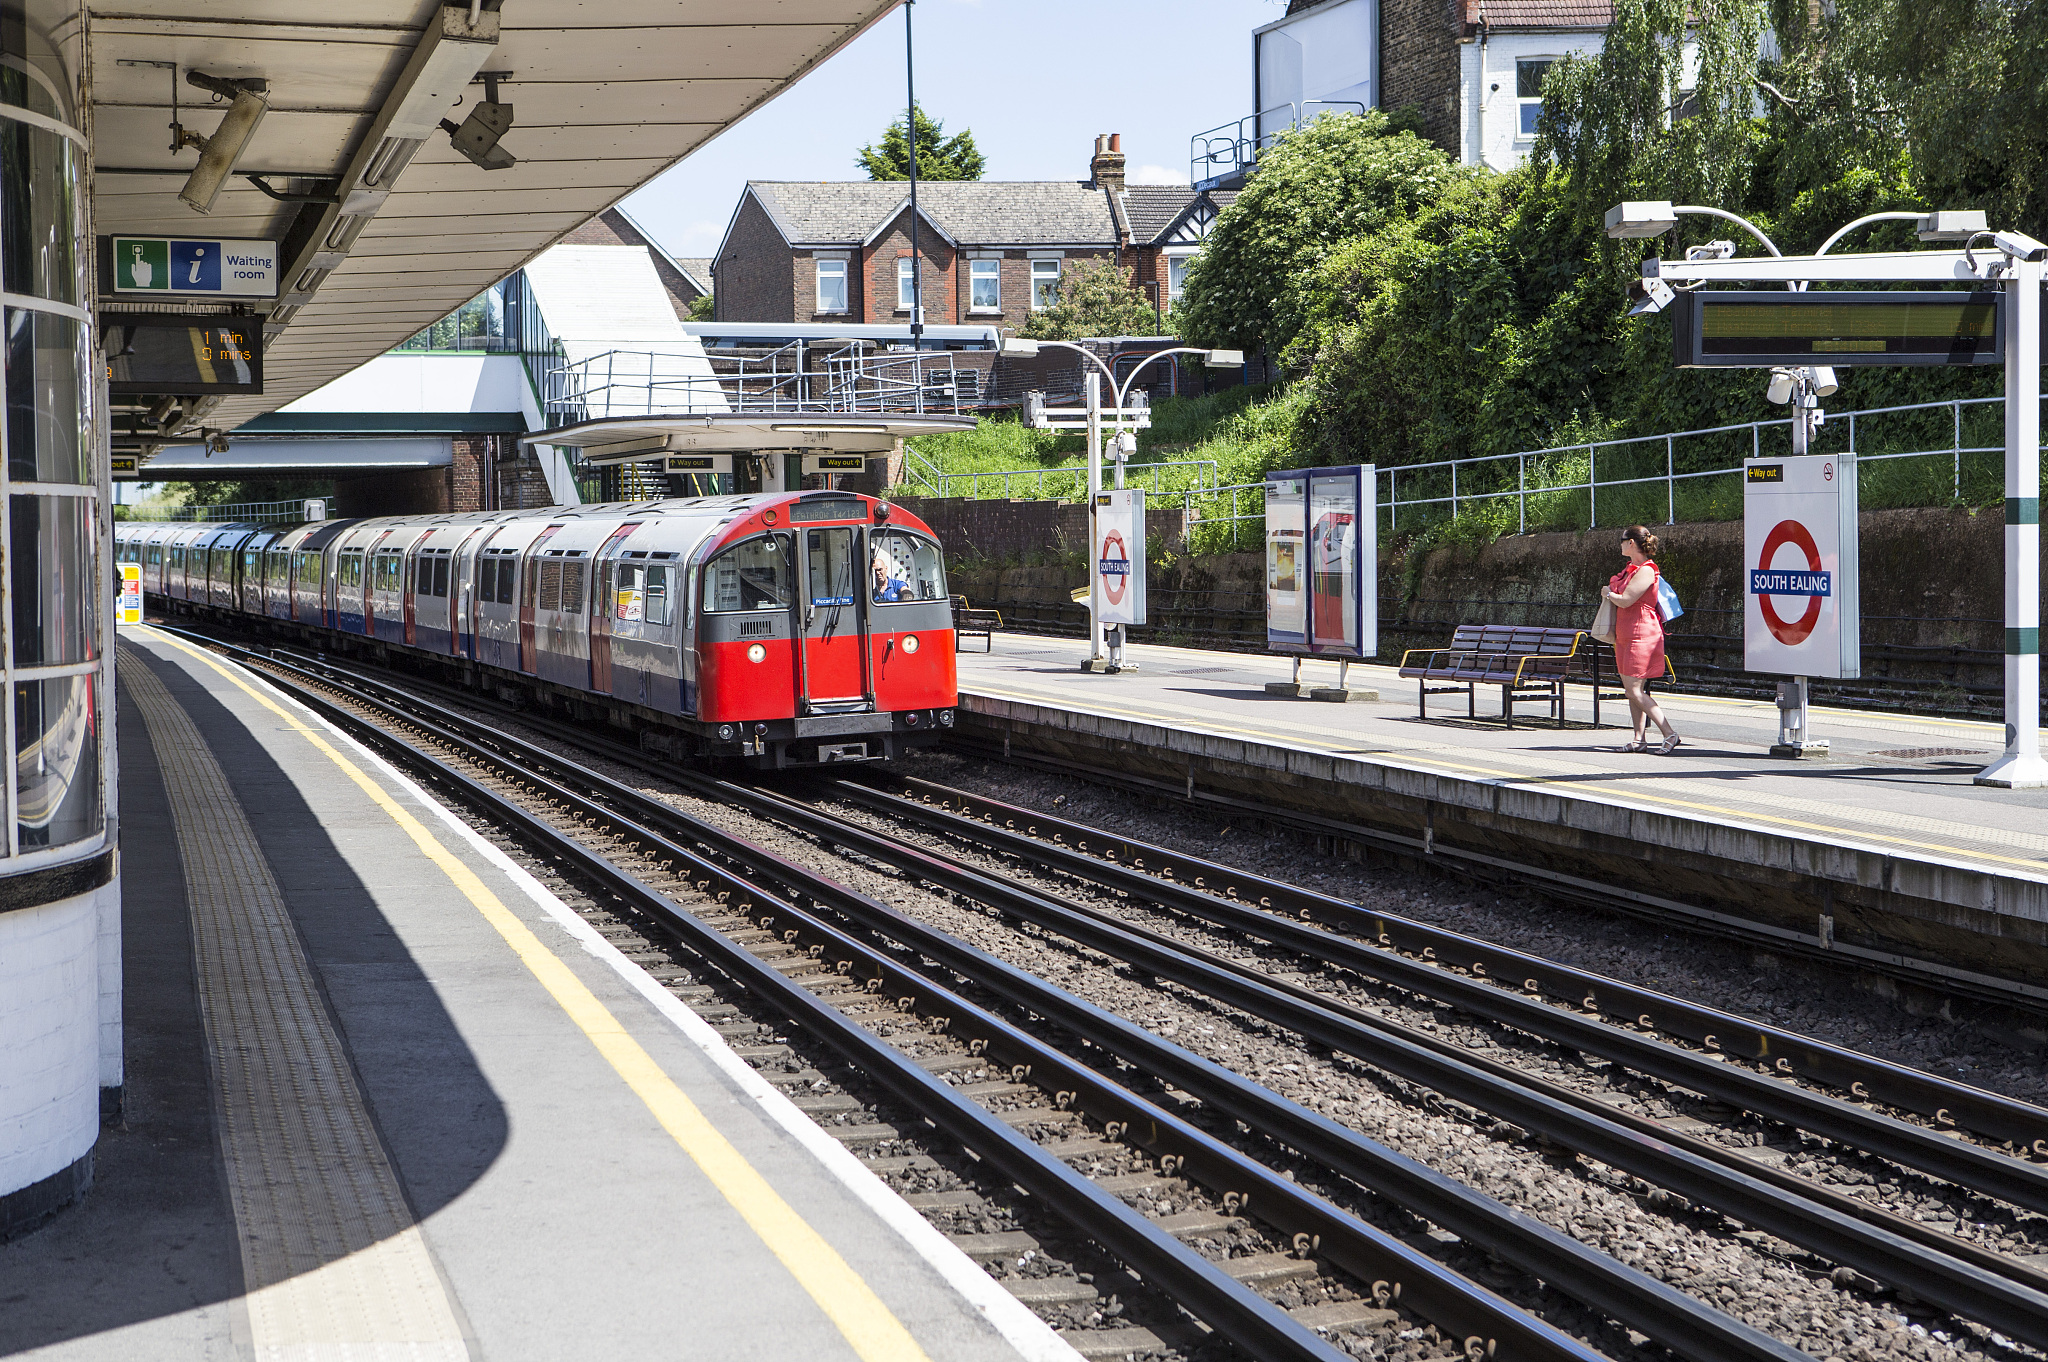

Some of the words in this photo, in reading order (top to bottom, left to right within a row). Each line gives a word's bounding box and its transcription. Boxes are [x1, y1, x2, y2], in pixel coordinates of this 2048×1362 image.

[226, 255, 272, 268] Waiting
[234, 269, 265, 279] room
[204, 331, 209, 344] 1
[220, 332, 243, 343] min
[220, 347, 251, 360] mins
[828, 459, 841, 467] Way
[1753, 468, 1766, 479] Way
[1766, 468, 1777, 477] out
[821, 501, 835, 509] 304
[792, 511, 828, 520] HEATHROW
[1101, 562, 1113, 572] SOUTH
[1114, 562, 1129, 573] EALING
[1754, 574, 1787, 590] SOUTH
[1790, 575, 1828, 592] EALING
